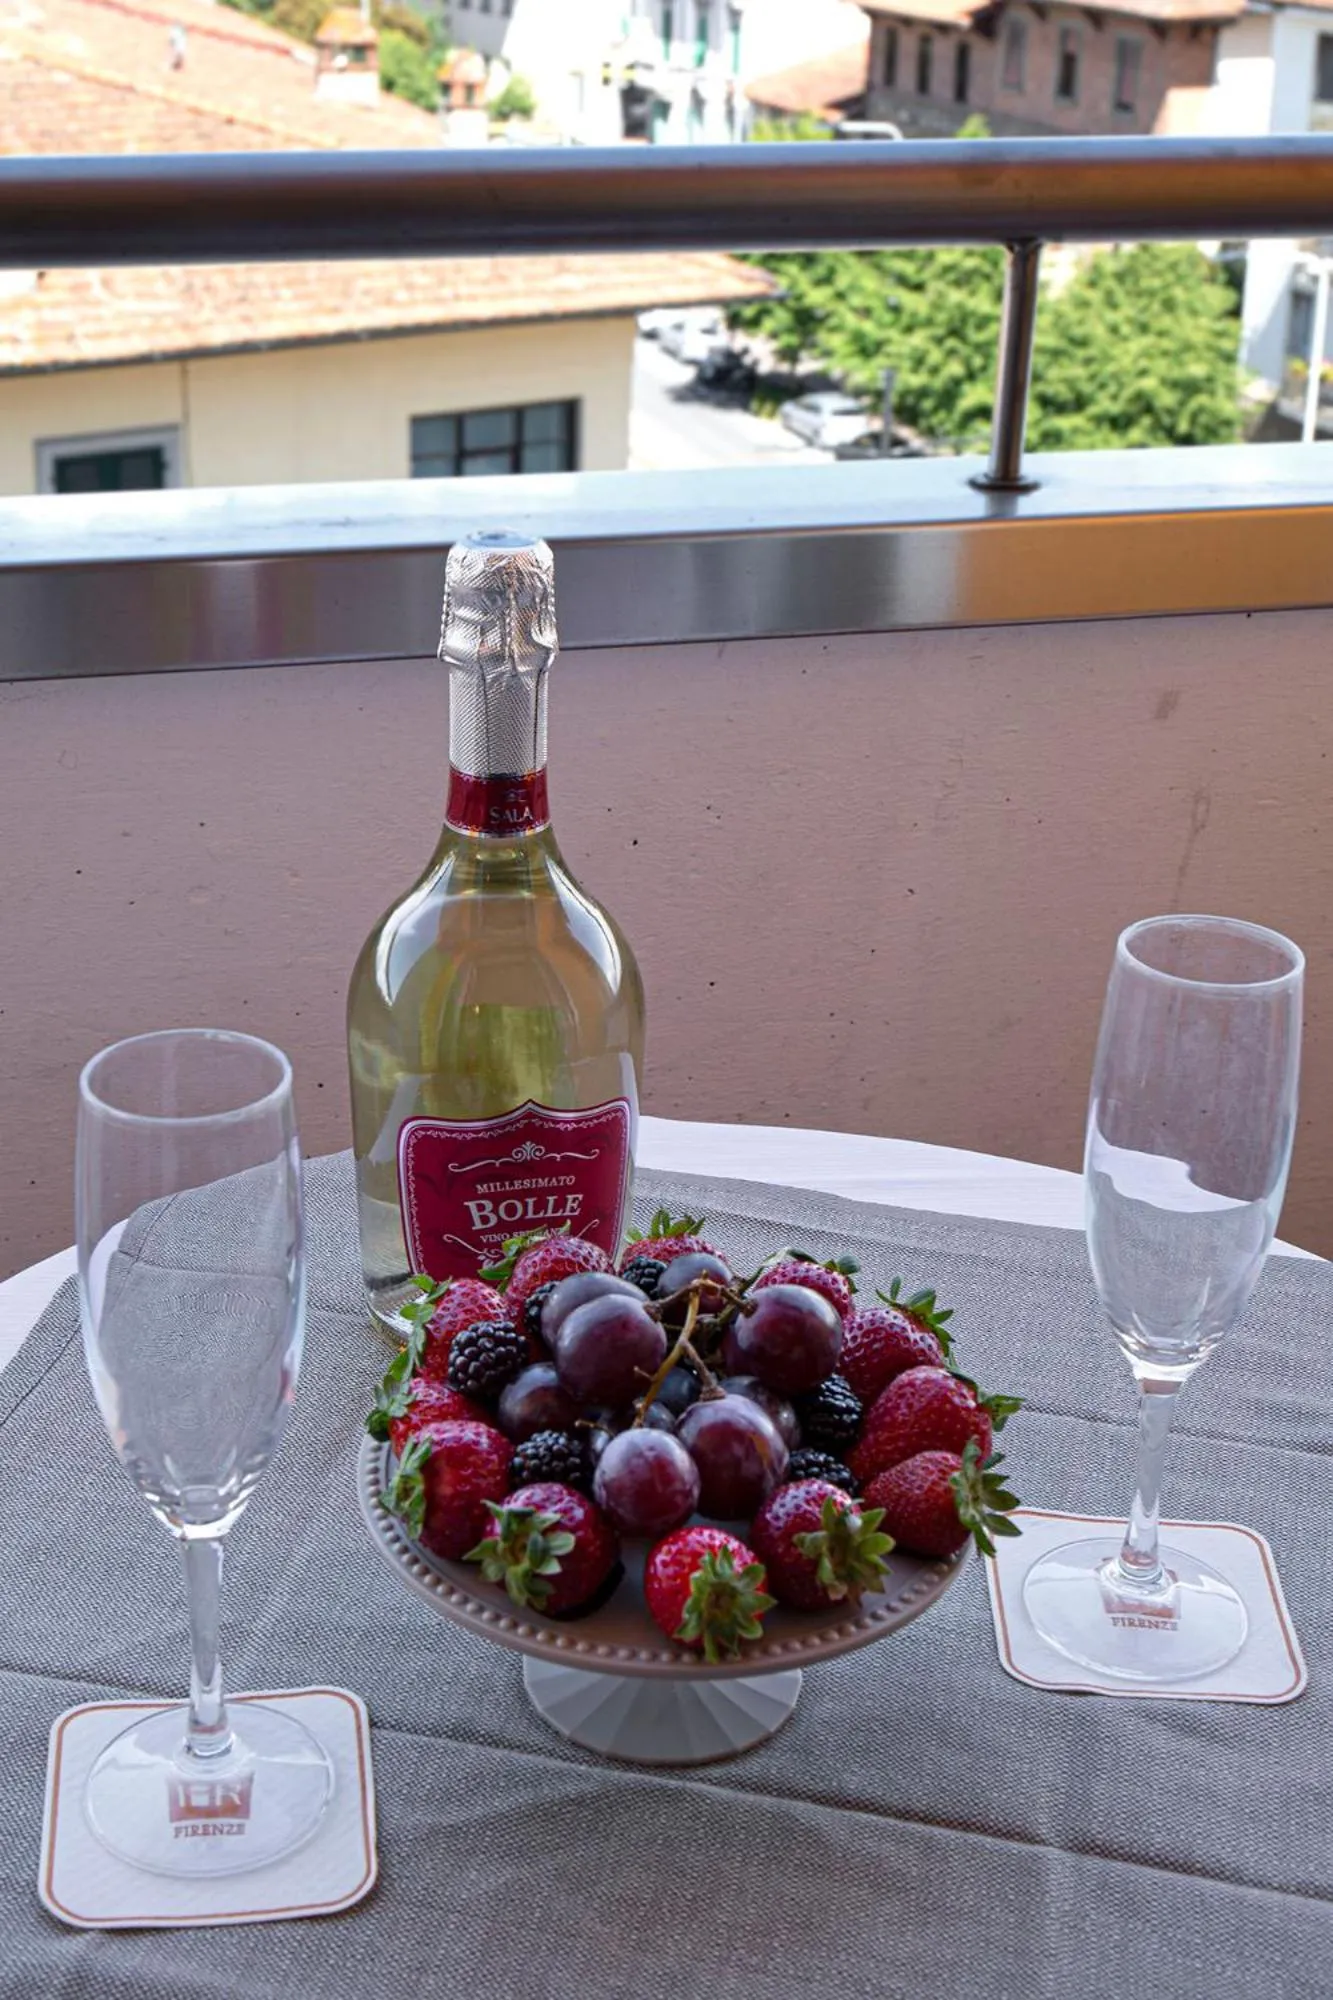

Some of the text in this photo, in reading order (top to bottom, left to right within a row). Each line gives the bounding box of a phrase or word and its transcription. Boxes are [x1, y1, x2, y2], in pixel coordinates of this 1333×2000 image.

[489, 806, 534, 824] SALA
[476, 1175, 576, 1194] MILLESIMATO
[464, 1194, 584, 1230] BOLLE
[480, 1232, 510, 1243] VINO
[1111, 1616, 1178, 1631] FIRENZE
[173, 1823, 246, 1839] FIRENZE
